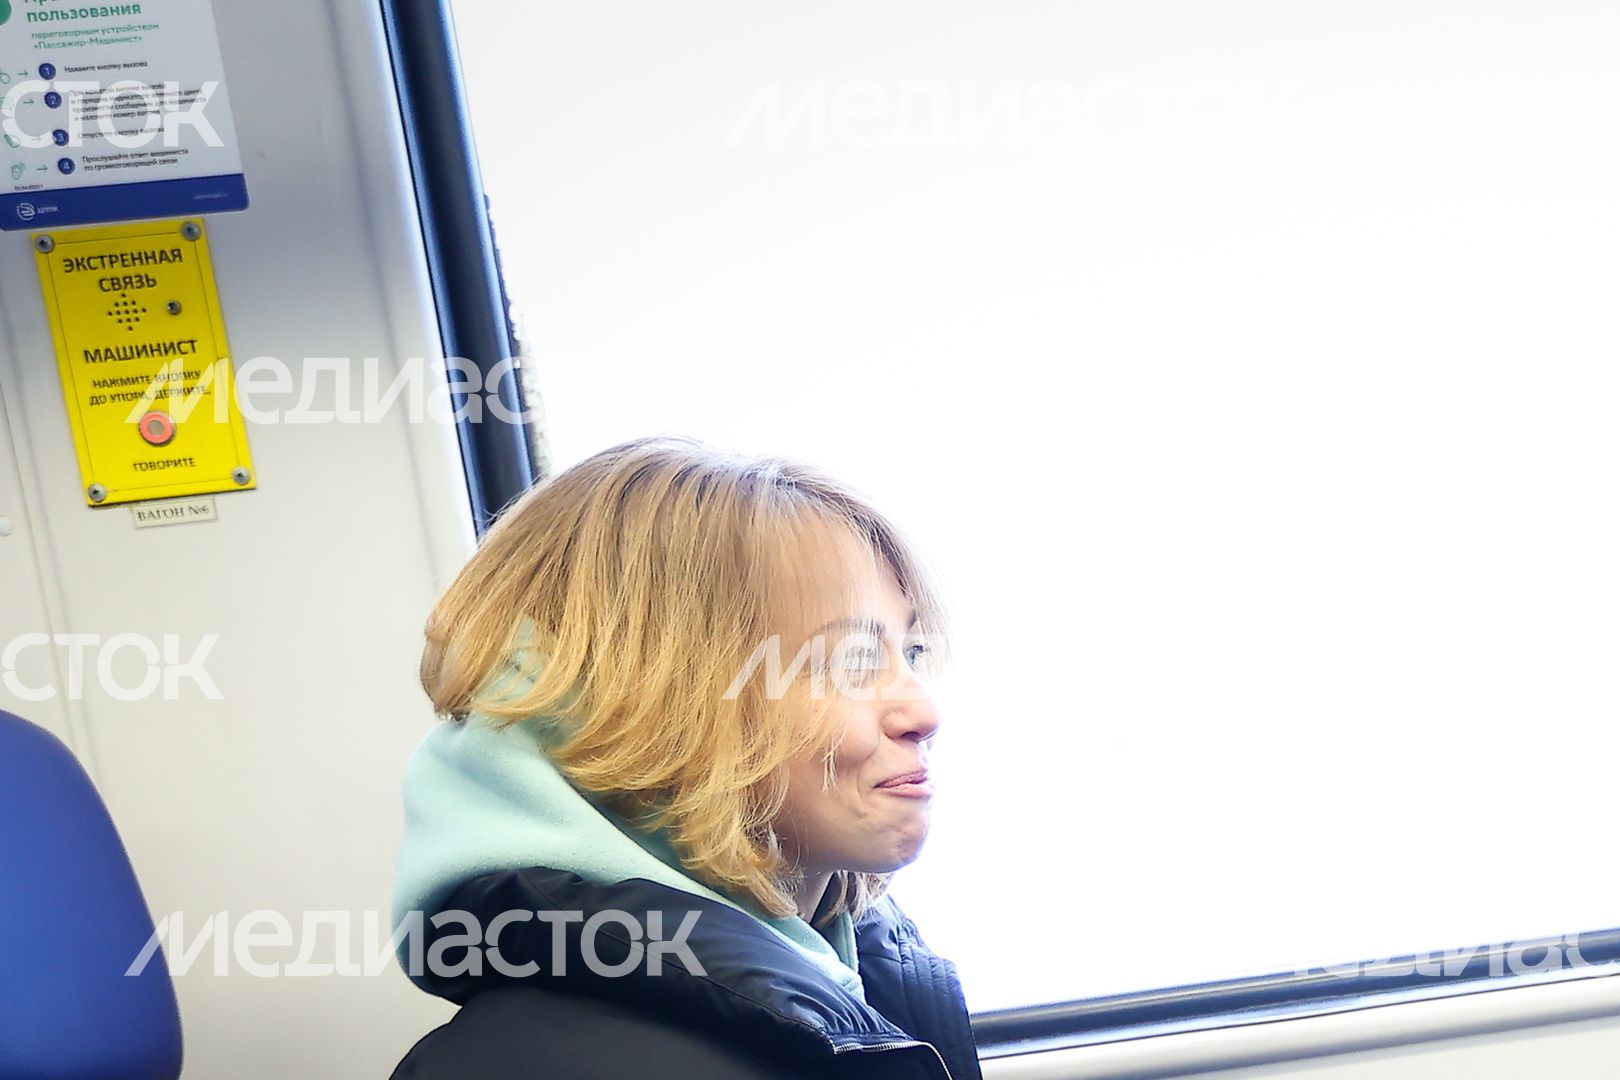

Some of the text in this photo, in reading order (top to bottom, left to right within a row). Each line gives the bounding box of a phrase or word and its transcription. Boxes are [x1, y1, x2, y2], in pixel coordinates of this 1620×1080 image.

[27, 3, 142, 23] пользования
[62, 248, 183, 273] ЭКСТРЕННАЯ
[98, 274, 157, 293] СВЯЗЬ
[83, 339, 198, 364] МАШИНИСТ
[92, 370, 201, 389] НАЖМИТЕ КНОПКУ
[90, 395, 107, 406] ДО
[133, 457, 196, 472] ГОВОРИТЕ
[137, 507, 185, 522] ВАГОН
